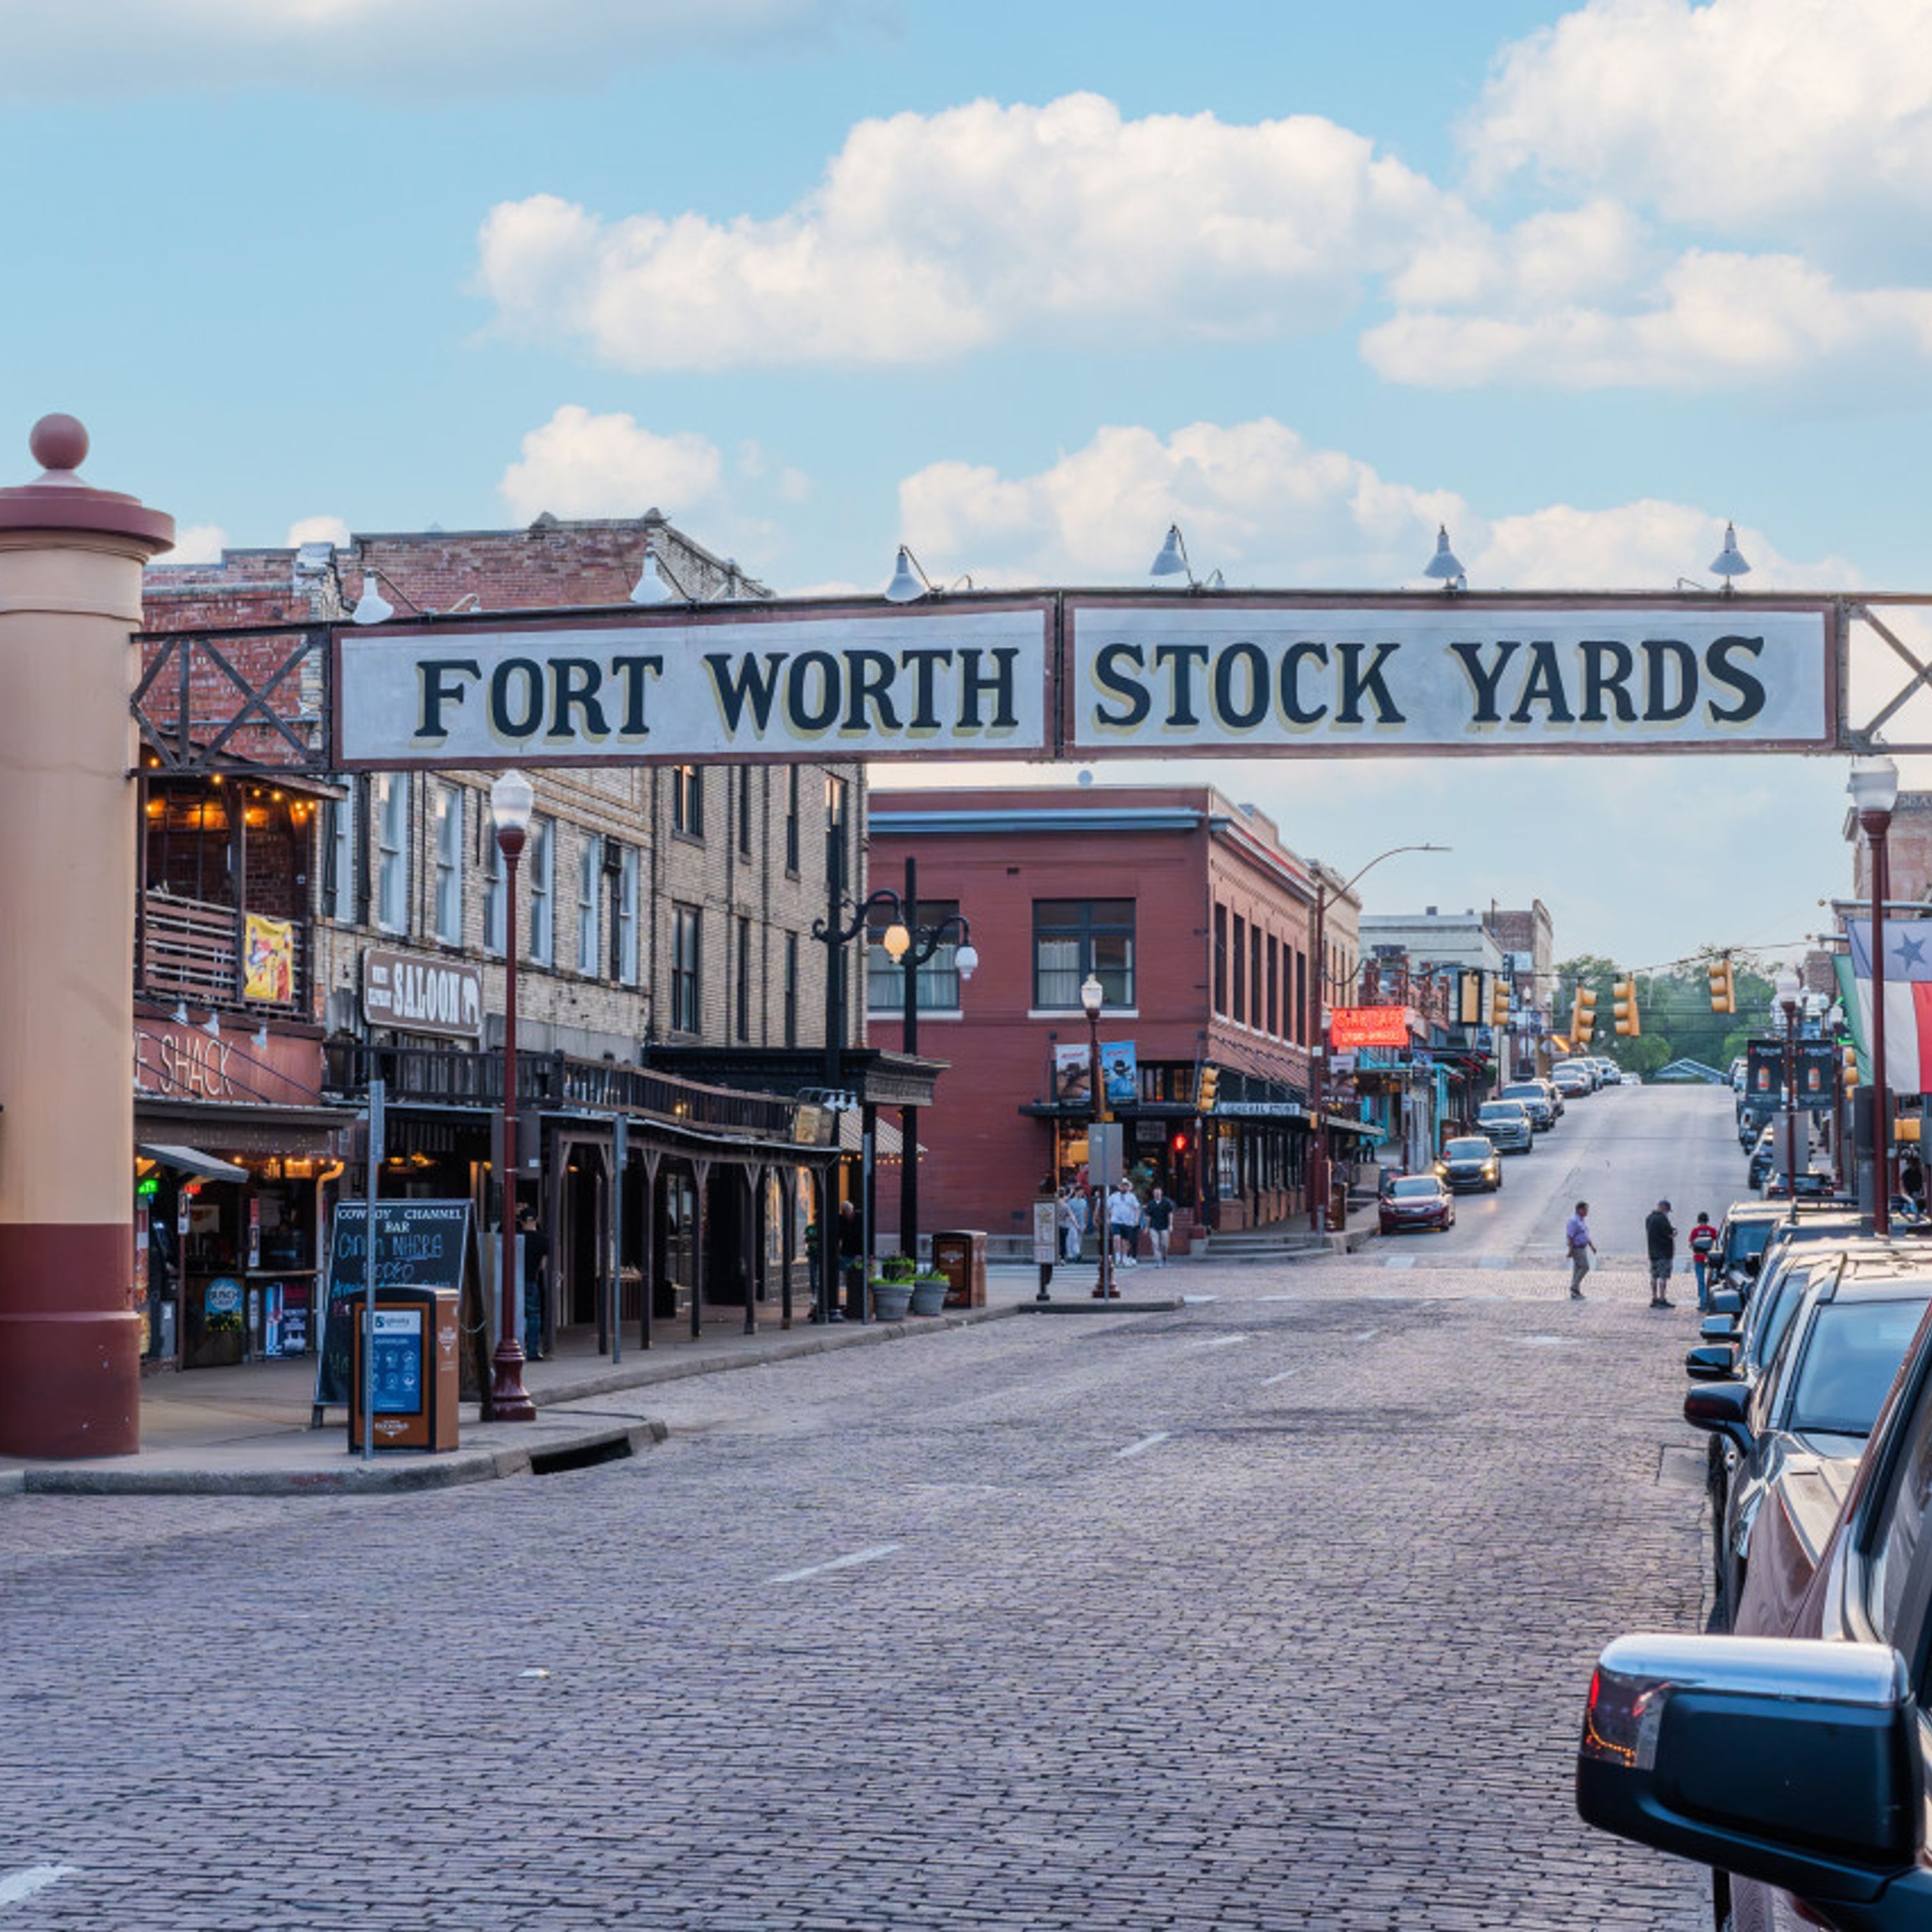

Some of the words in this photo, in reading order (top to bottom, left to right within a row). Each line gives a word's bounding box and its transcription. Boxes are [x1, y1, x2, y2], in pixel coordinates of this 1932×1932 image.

[413, 654, 663, 738] FORT
[704, 647, 1019, 733] WORTH
[1095, 643, 1406, 728] STOCK
[1450, 636, 1766, 723] YARDS
[393, 962, 460, 1023] SALOON
[160, 1034, 233, 1095] SHACK
[338, 1209, 392, 1220] COWOY
[404, 1209, 463, 1220] CHANNEL
[384, 1221, 410, 1233] BAR
